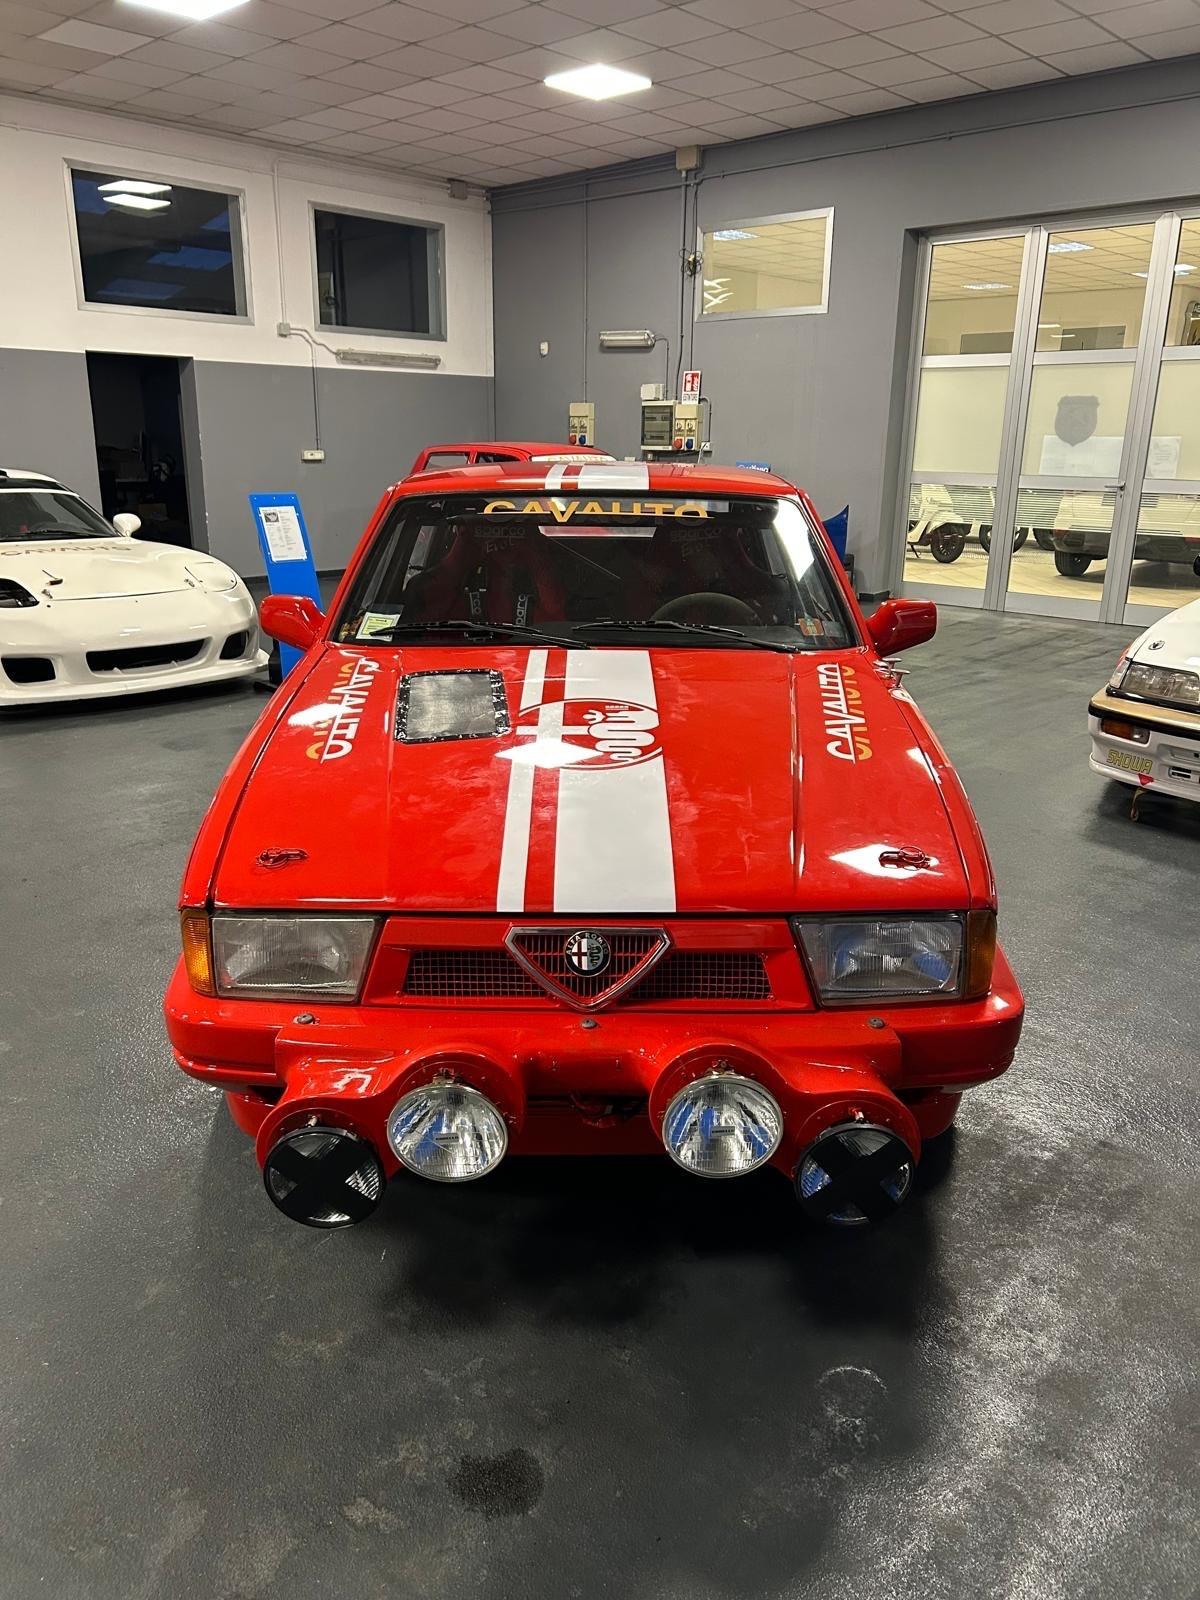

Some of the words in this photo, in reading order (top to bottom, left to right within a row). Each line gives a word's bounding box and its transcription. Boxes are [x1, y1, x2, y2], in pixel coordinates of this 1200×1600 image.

[482, 500, 711, 524] CAVAUTO
[474, 526, 526, 538] sparco
[515, 593, 529, 626] parc
[816, 662, 873, 765] CAVAUTO
[1106, 748, 1154, 775] SHOWA
[565, 935, 581, 955] ALFA
